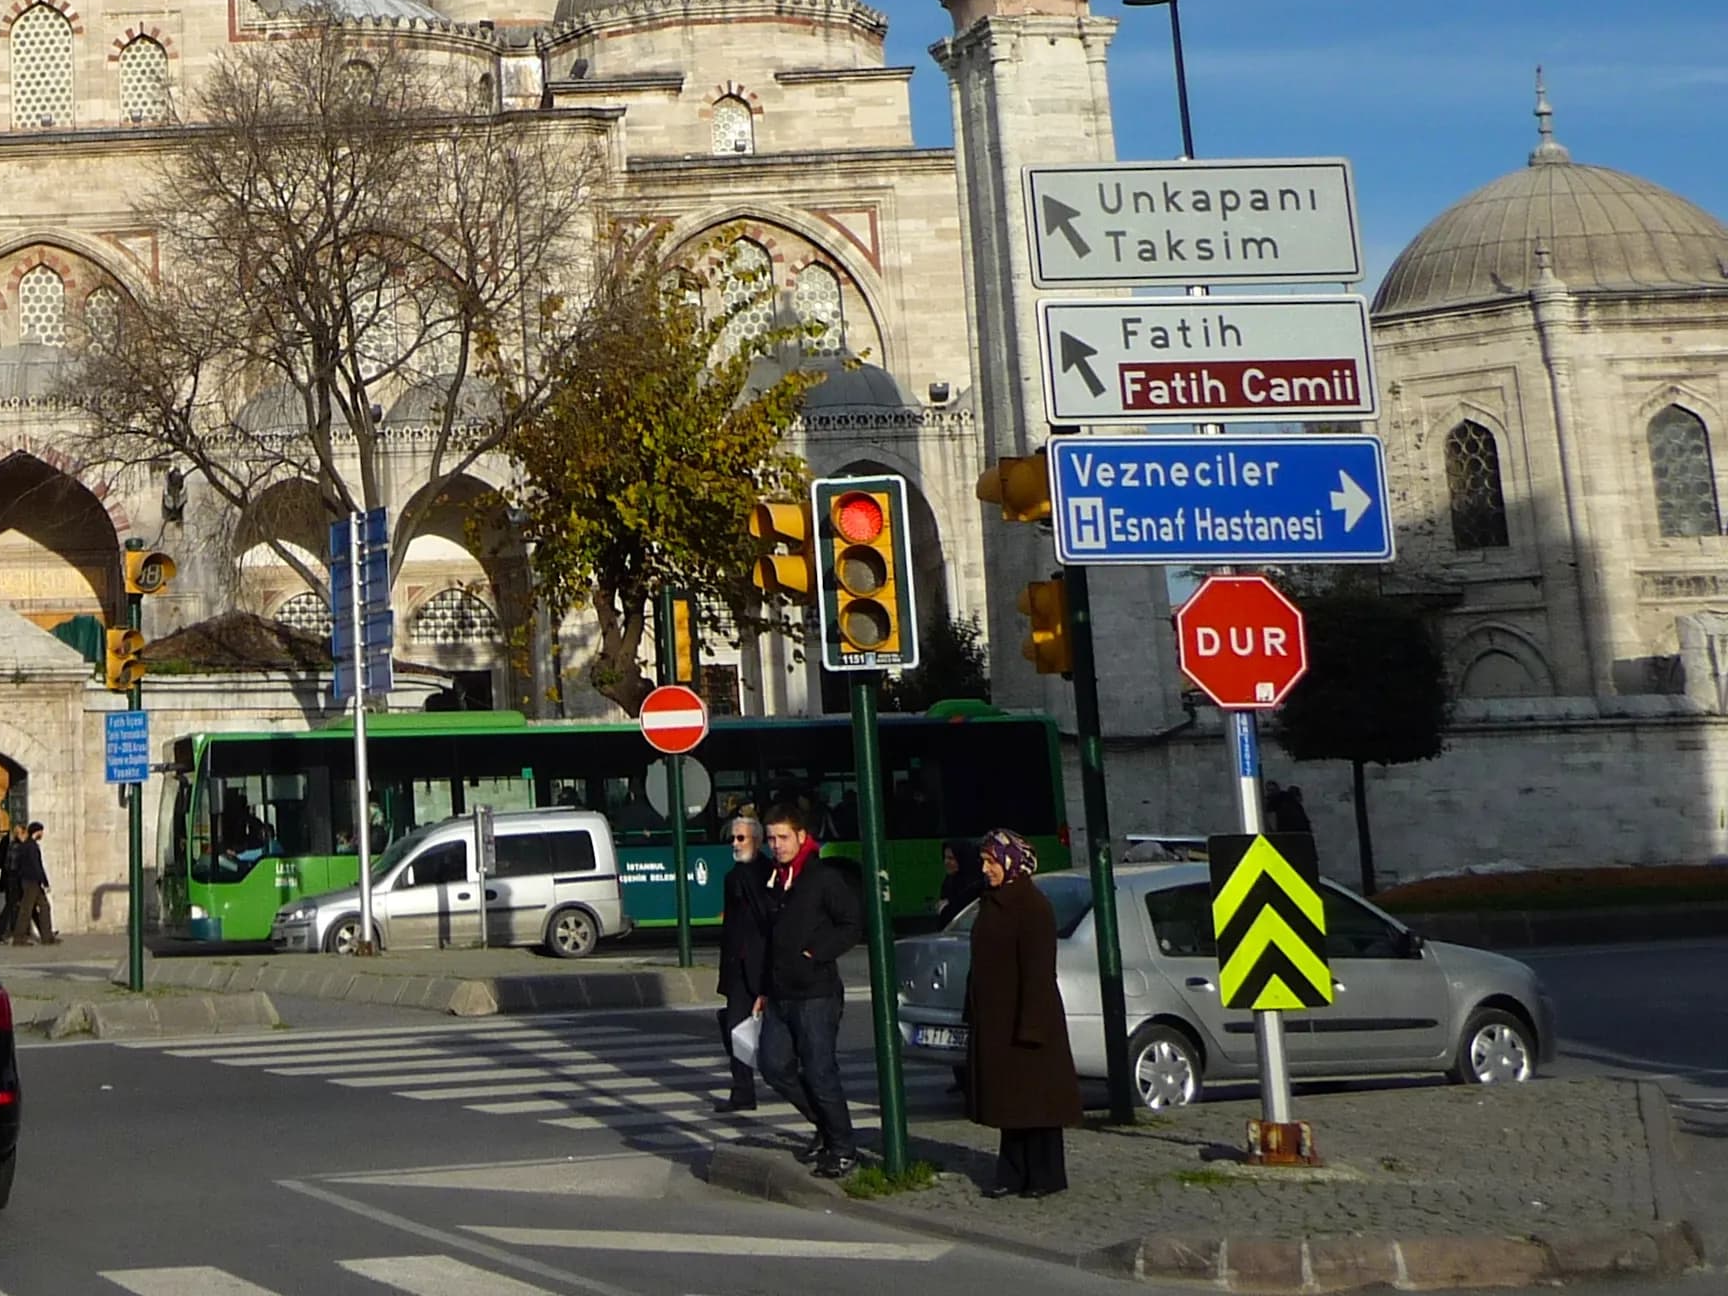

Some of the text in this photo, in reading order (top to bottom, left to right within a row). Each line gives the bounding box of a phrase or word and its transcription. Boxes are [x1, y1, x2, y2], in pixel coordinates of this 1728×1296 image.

[1098, 182, 1317, 221] Unkapanı
[1105, 230, 1279, 262] Taksim
[1121, 315, 1242, 349] Fatih
[1123, 368, 1354, 405] Fatih Camii
[1071, 452, 1280, 488] Vezneciler
[1076, 502, 1324, 544] H Esnaf Hastanesi
[1196, 627, 1288, 656] DUR
